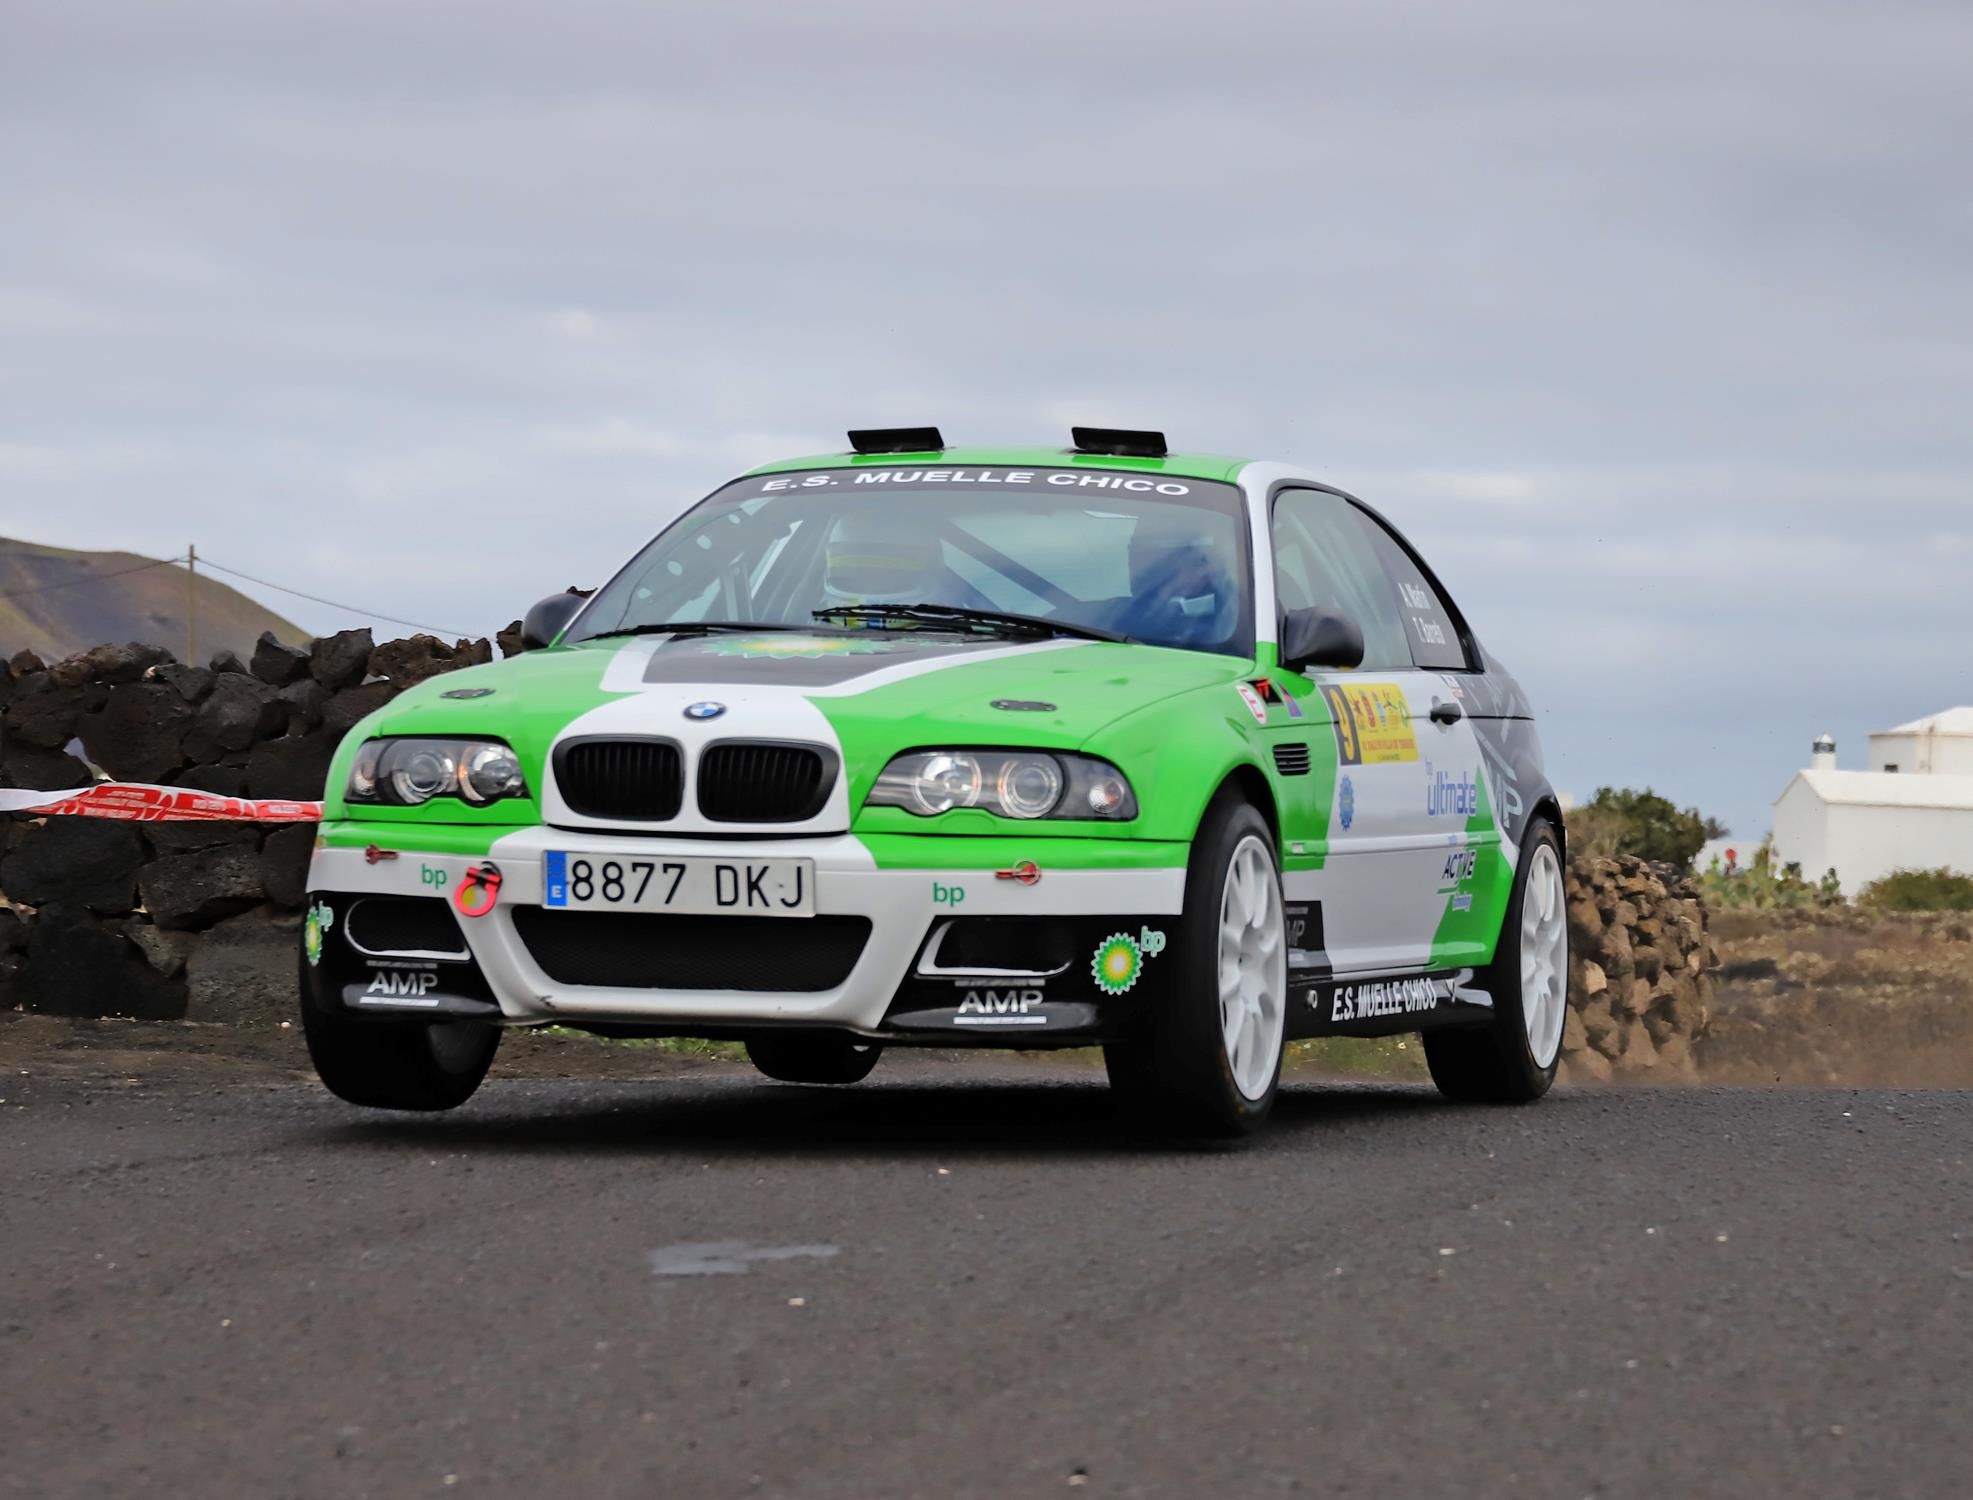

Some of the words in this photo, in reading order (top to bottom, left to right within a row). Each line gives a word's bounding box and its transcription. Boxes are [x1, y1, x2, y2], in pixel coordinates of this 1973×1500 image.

[761, 474, 839, 492] E.S.
[854, 471, 1035, 485] MUELLE
[1047, 473, 1190, 496] CHICO
[1329, 688, 1355, 761] 9
[421, 863, 447, 889] bp
[571, 859, 687, 905] 8877
[715, 864, 803, 909] DKJ
[551, 885, 562, 898] E
[932, 882, 965, 907] bp
[1140, 925, 1166, 957] bp
[366, 971, 438, 996] AMP
[958, 990, 1044, 1014] AMP
[1331, 986, 1355, 1021] E.S.
[1357, 981, 1403, 1018] MUELLE
[1402, 977, 1437, 1012] CHICO
